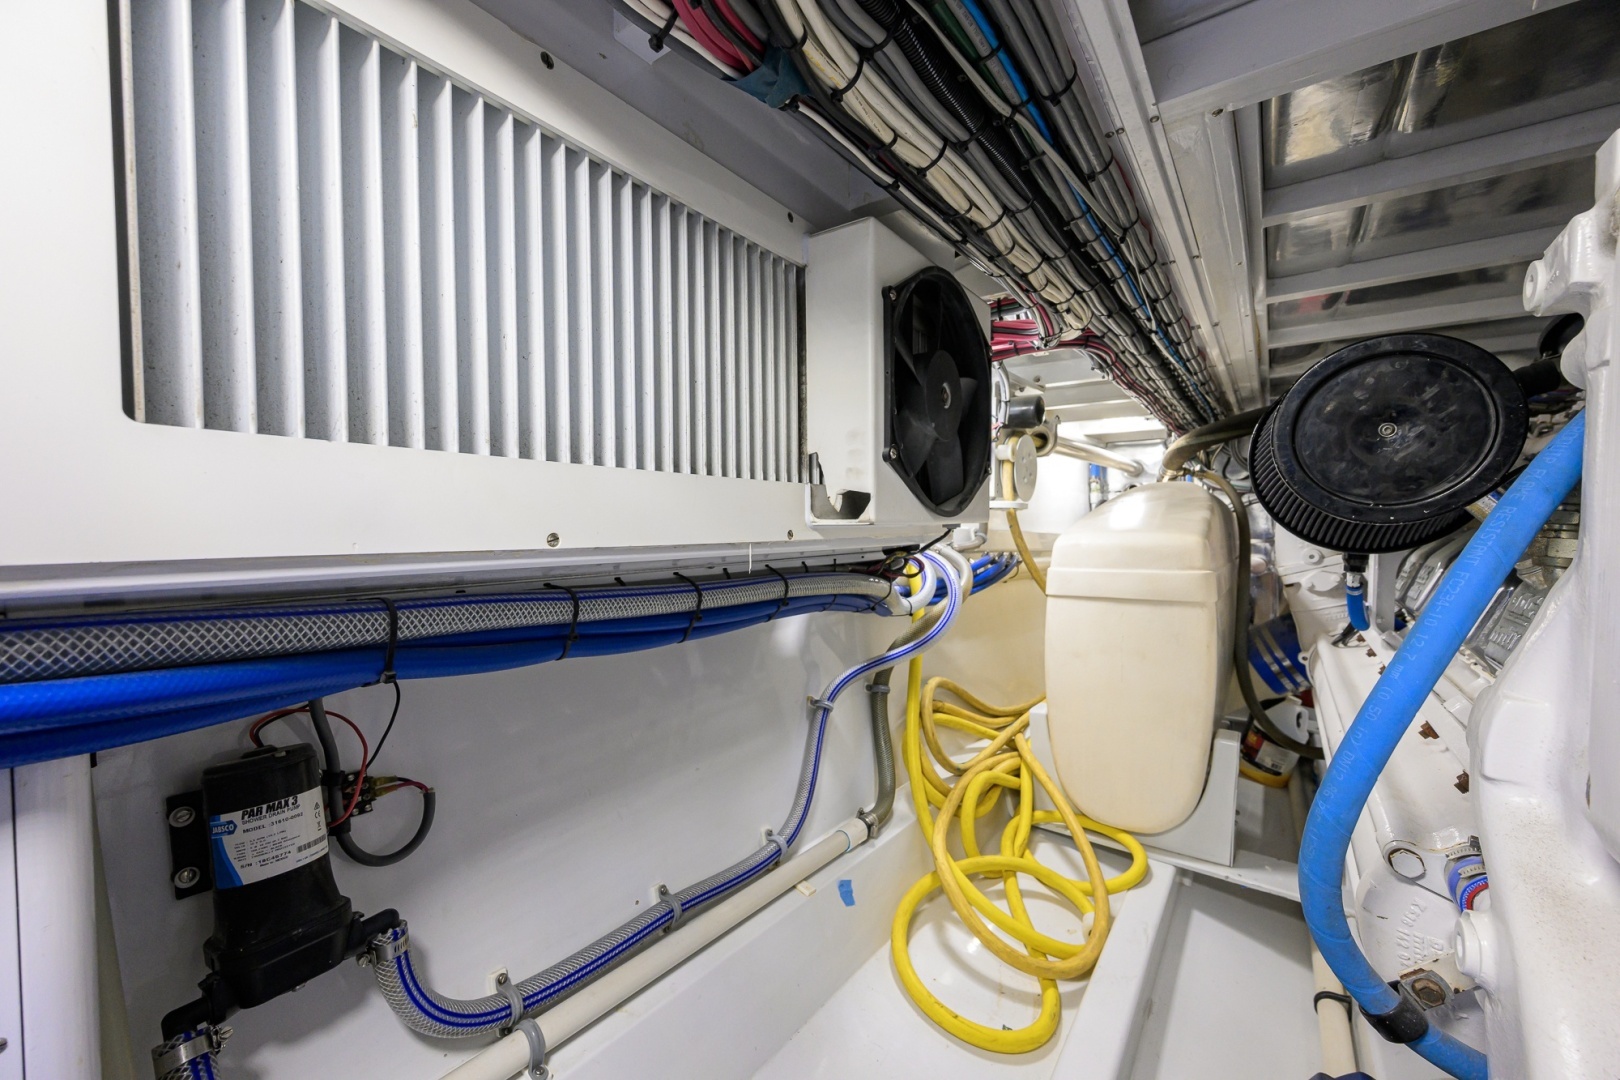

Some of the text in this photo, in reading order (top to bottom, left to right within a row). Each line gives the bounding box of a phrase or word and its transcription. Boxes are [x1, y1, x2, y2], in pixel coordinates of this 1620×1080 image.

[1511, 468, 1547, 502] FLAME
[1464, 505, 1518, 566] RESISTANT
[1424, 571, 1470, 627] FC234-10
[1409, 633, 1426, 662] 12.7
[1335, 751, 1356, 782] DN12
[1322, 783, 1339, 799] 86
[241, 795, 299, 820] PAR MAX 3
[241, 804, 301, 825] SHOWER DRAIN PUMP
[212, 825, 235, 834] JABSCO
[242, 824, 266, 834] MODEL
